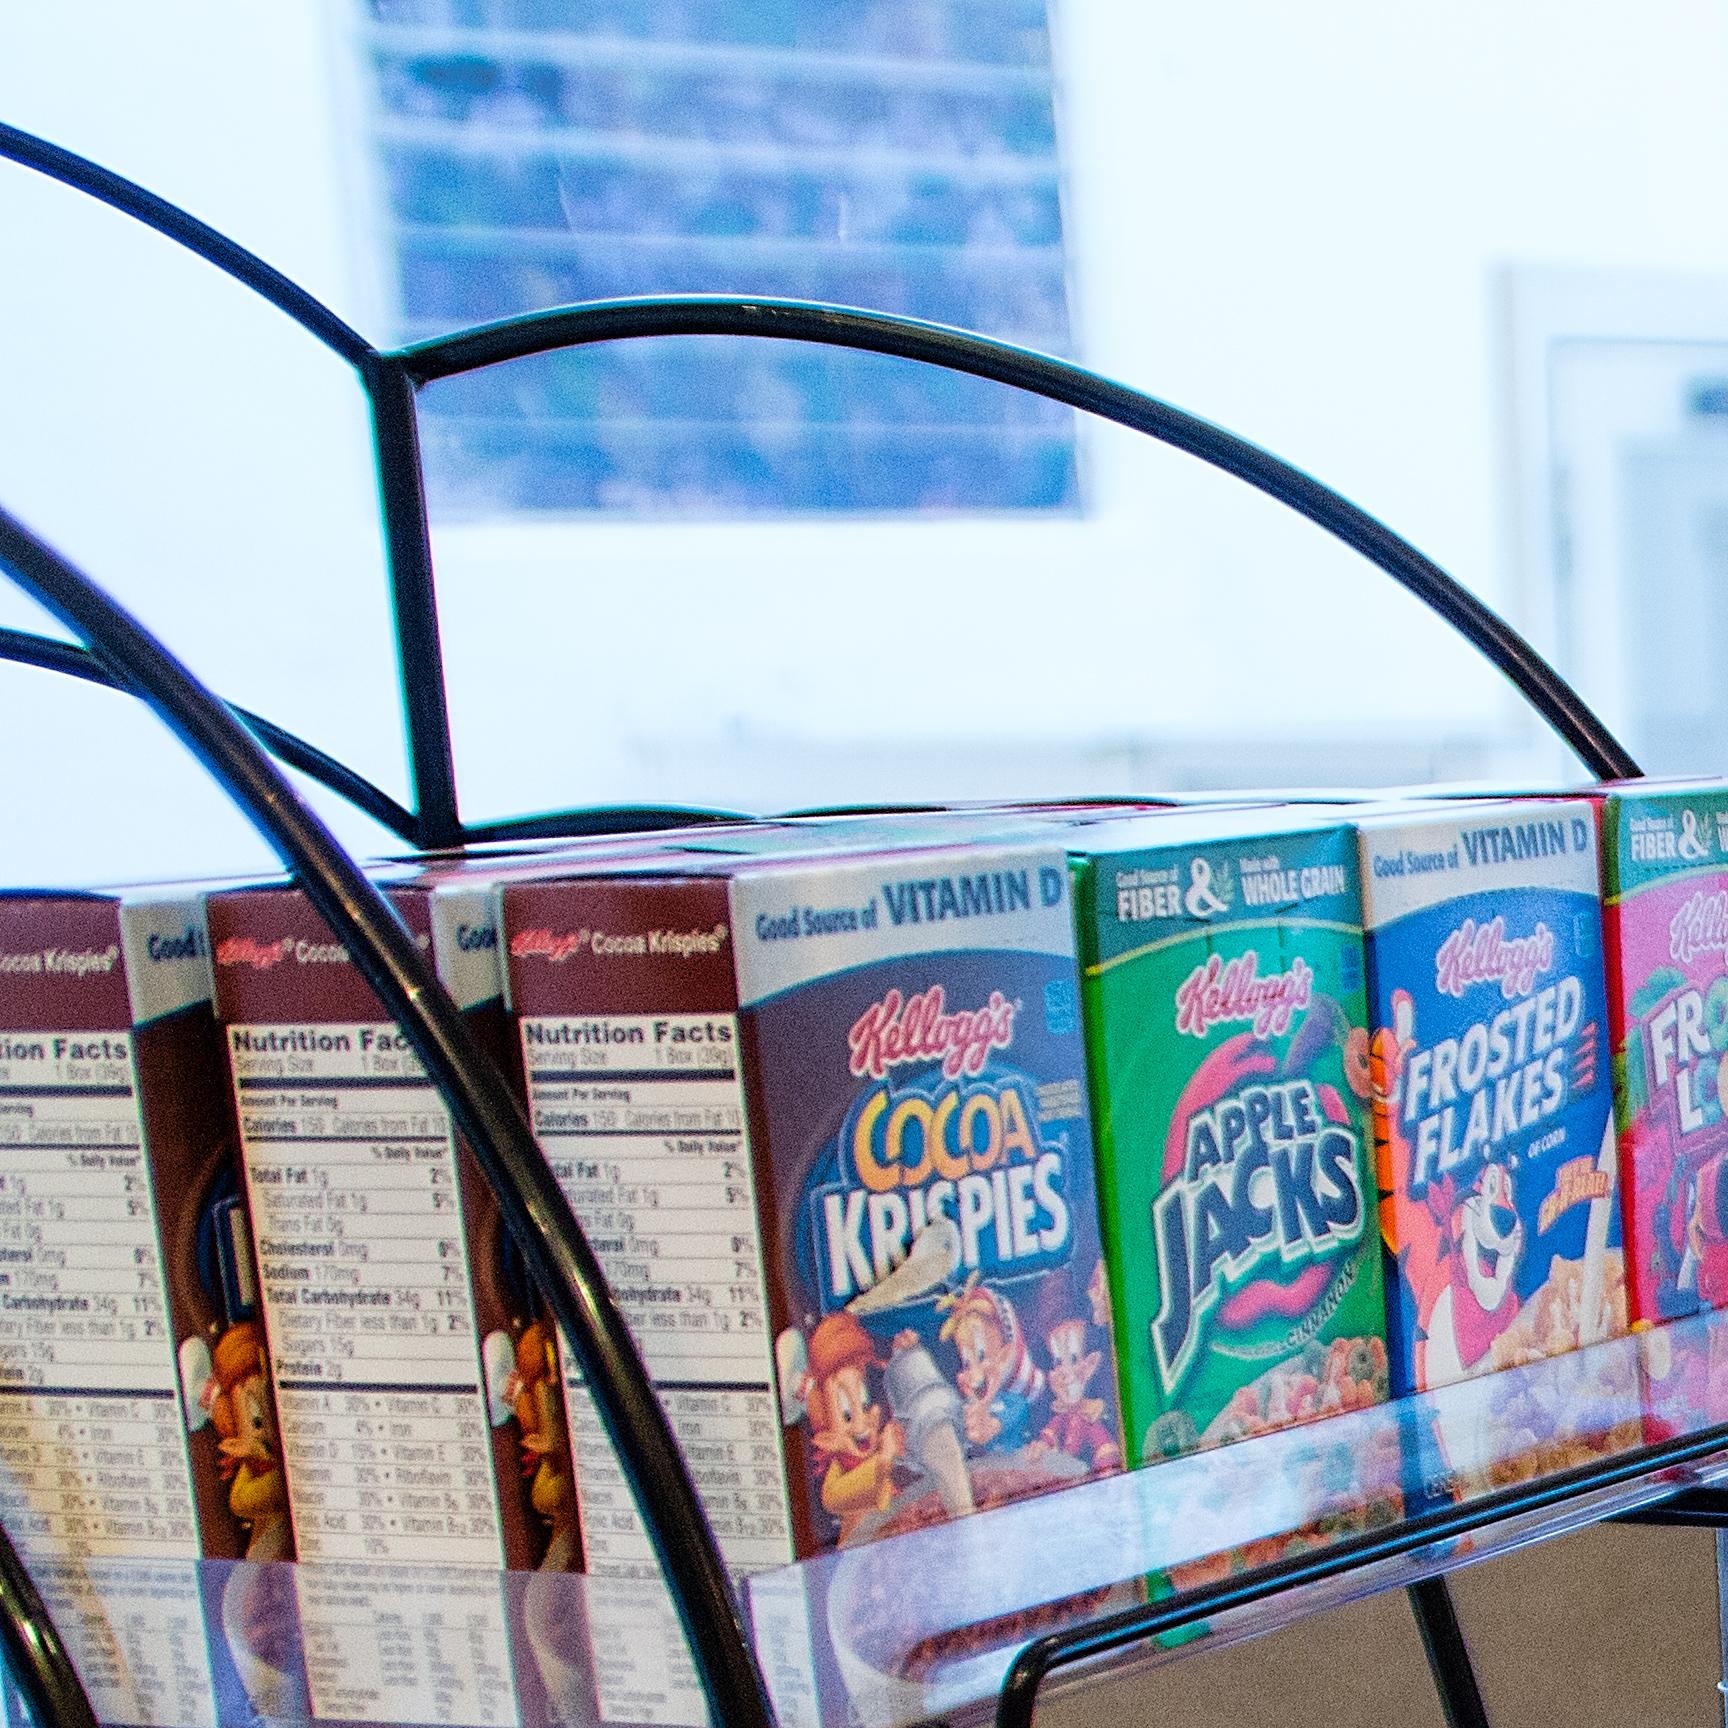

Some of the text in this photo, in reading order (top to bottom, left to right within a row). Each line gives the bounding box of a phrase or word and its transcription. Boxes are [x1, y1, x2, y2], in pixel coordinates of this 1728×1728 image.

[1374, 818, 1588, 879] Good Source of VITAMIN D
[1632, 831, 1677, 861] FIBER
[1678, 809, 1709, 860] &
[755, 865, 1062, 941] Good Source of VITAMIN D
[1117, 885, 1182, 921] FIBER
[1185, 857, 1229, 917] &
[1242, 865, 1346, 907] WHOLE GRAIN
[590, 931, 648, 955] Cocoa
[1436, 915, 1554, 998] Kellogg's
[1176, 949, 1313, 1041] Kellogg's
[53, 1036, 129, 1061] Facts
[232, 1029, 414, 1052] Nutrition Fac
[525, 1020, 733, 1044] Nutrition Facts
[849, 984, 1015, 1079] Kellogg's
[1404, 975, 1582, 1121] FROSTED
[853, 1087, 1038, 1192] COCOA
[1186, 1082, 1318, 1184] APPLE
[1413, 1048, 1564, 1184] FLAKES
[824, 1152, 1071, 1297] KRISPIES
[1153, 1128, 1361, 1394] JACKS
